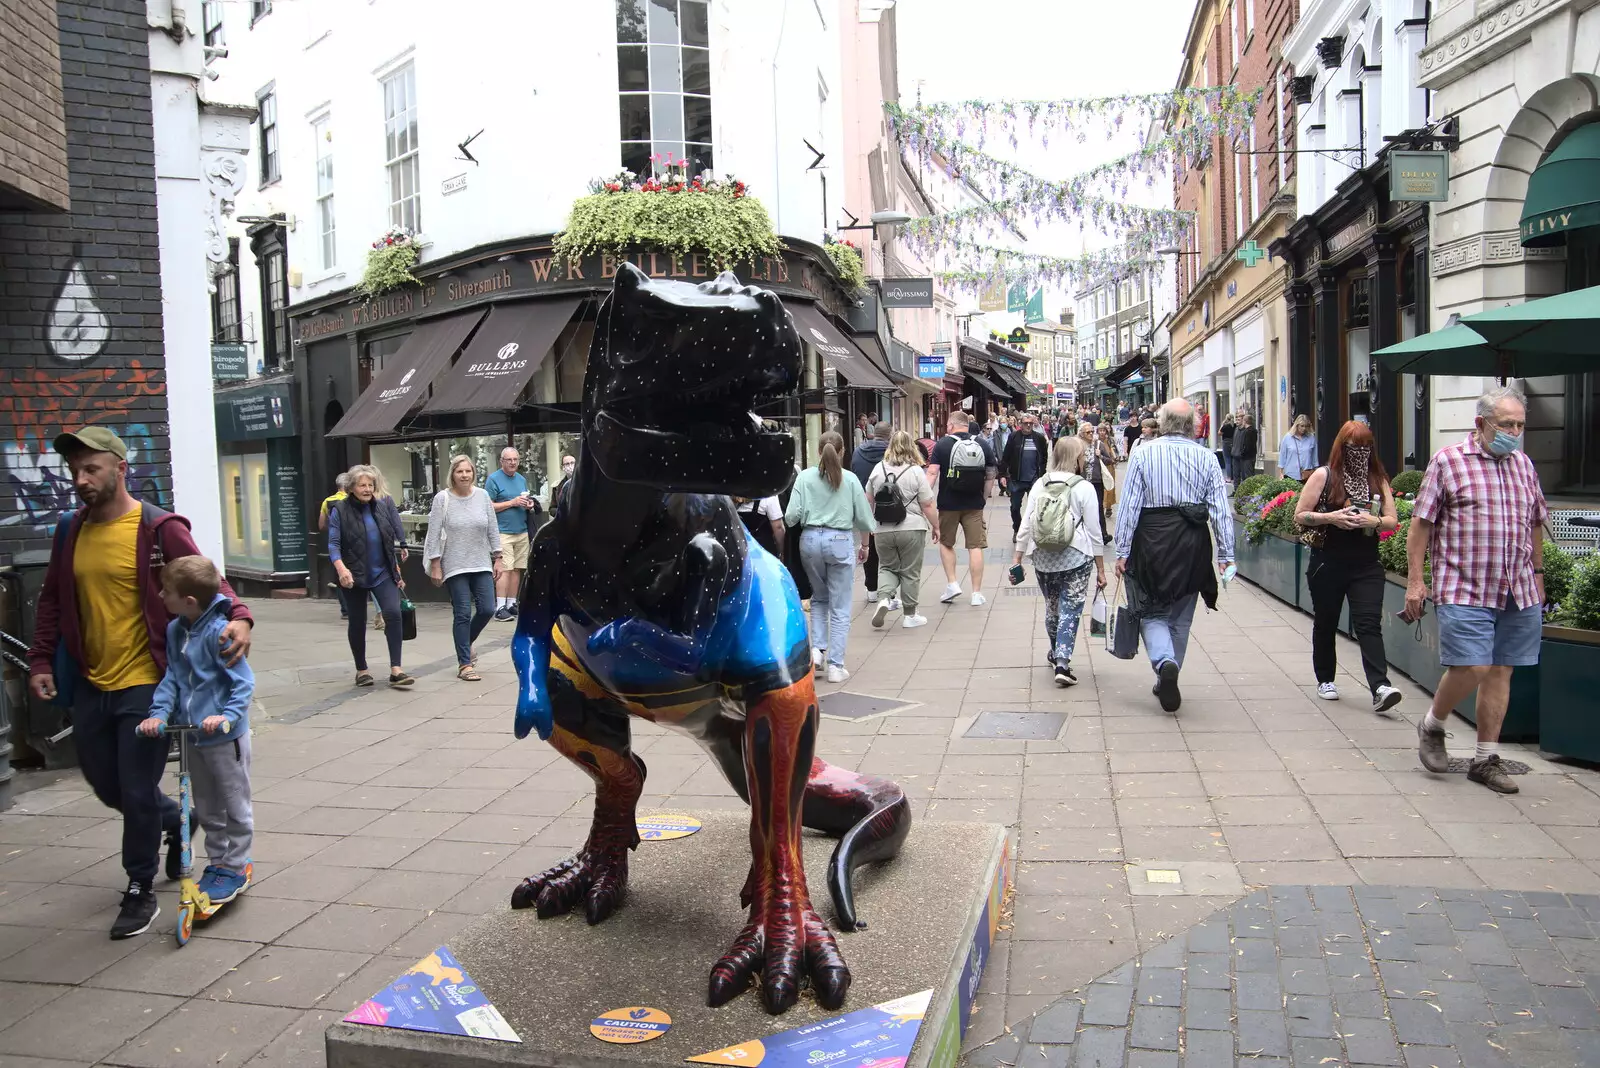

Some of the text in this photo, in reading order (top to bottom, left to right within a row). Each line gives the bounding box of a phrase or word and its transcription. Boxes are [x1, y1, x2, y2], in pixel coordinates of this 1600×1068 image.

[1540, 212, 1572, 232] IVY
[751, 256, 790, 284] LTD
[886, 288, 929, 299] BRAVISSIMO
[311, 314, 345, 336] Goldsmith
[371, 293, 415, 321] BULLEN
[448, 268, 512, 300] Silversmith
[213, 355, 245, 364] hiropody
[467, 359, 528, 373] BULLENS
[920, 364, 942, 373] to let
[379, 385, 413, 398] BULLENS
[604, 1020, 659, 1029] CAUTION
[797, 1025, 822, 1035] Lava
[821, 1018, 847, 1028] Land
[721, 1048, 748, 1061] 13
